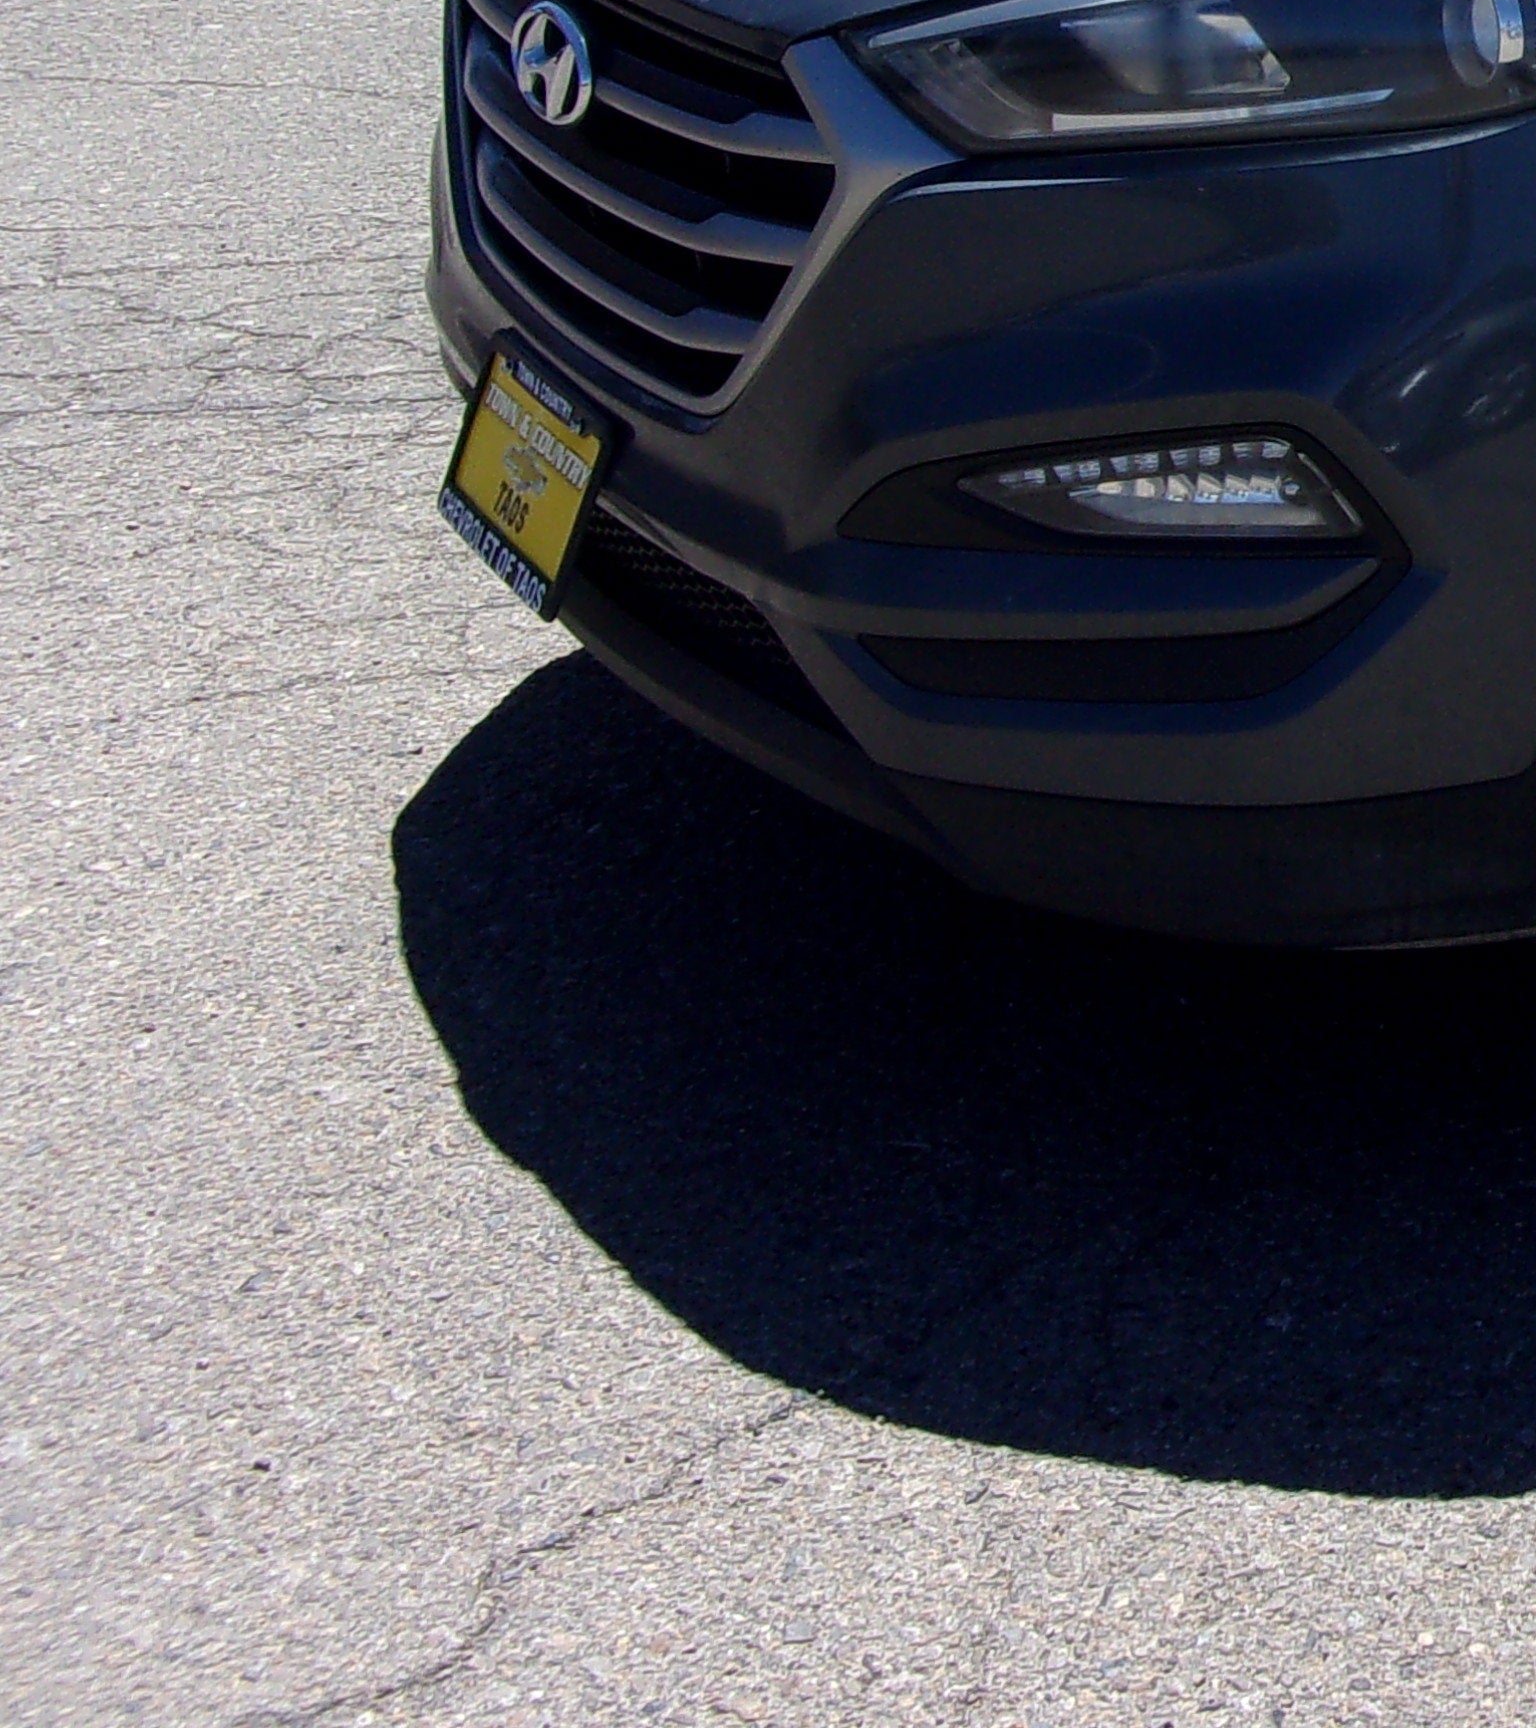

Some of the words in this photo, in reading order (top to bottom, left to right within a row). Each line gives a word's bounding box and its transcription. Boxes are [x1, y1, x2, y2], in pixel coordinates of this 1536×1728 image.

[484, 382, 518, 429] TOWN
[519, 413, 533, 441] &
[532, 425, 592, 491] COUNTRY
[441, 487, 501, 566] CHEVROLET
[496, 547, 517, 582] OF
[512, 562, 547, 612] TAOS
[493, 480, 530, 534] TAOS
